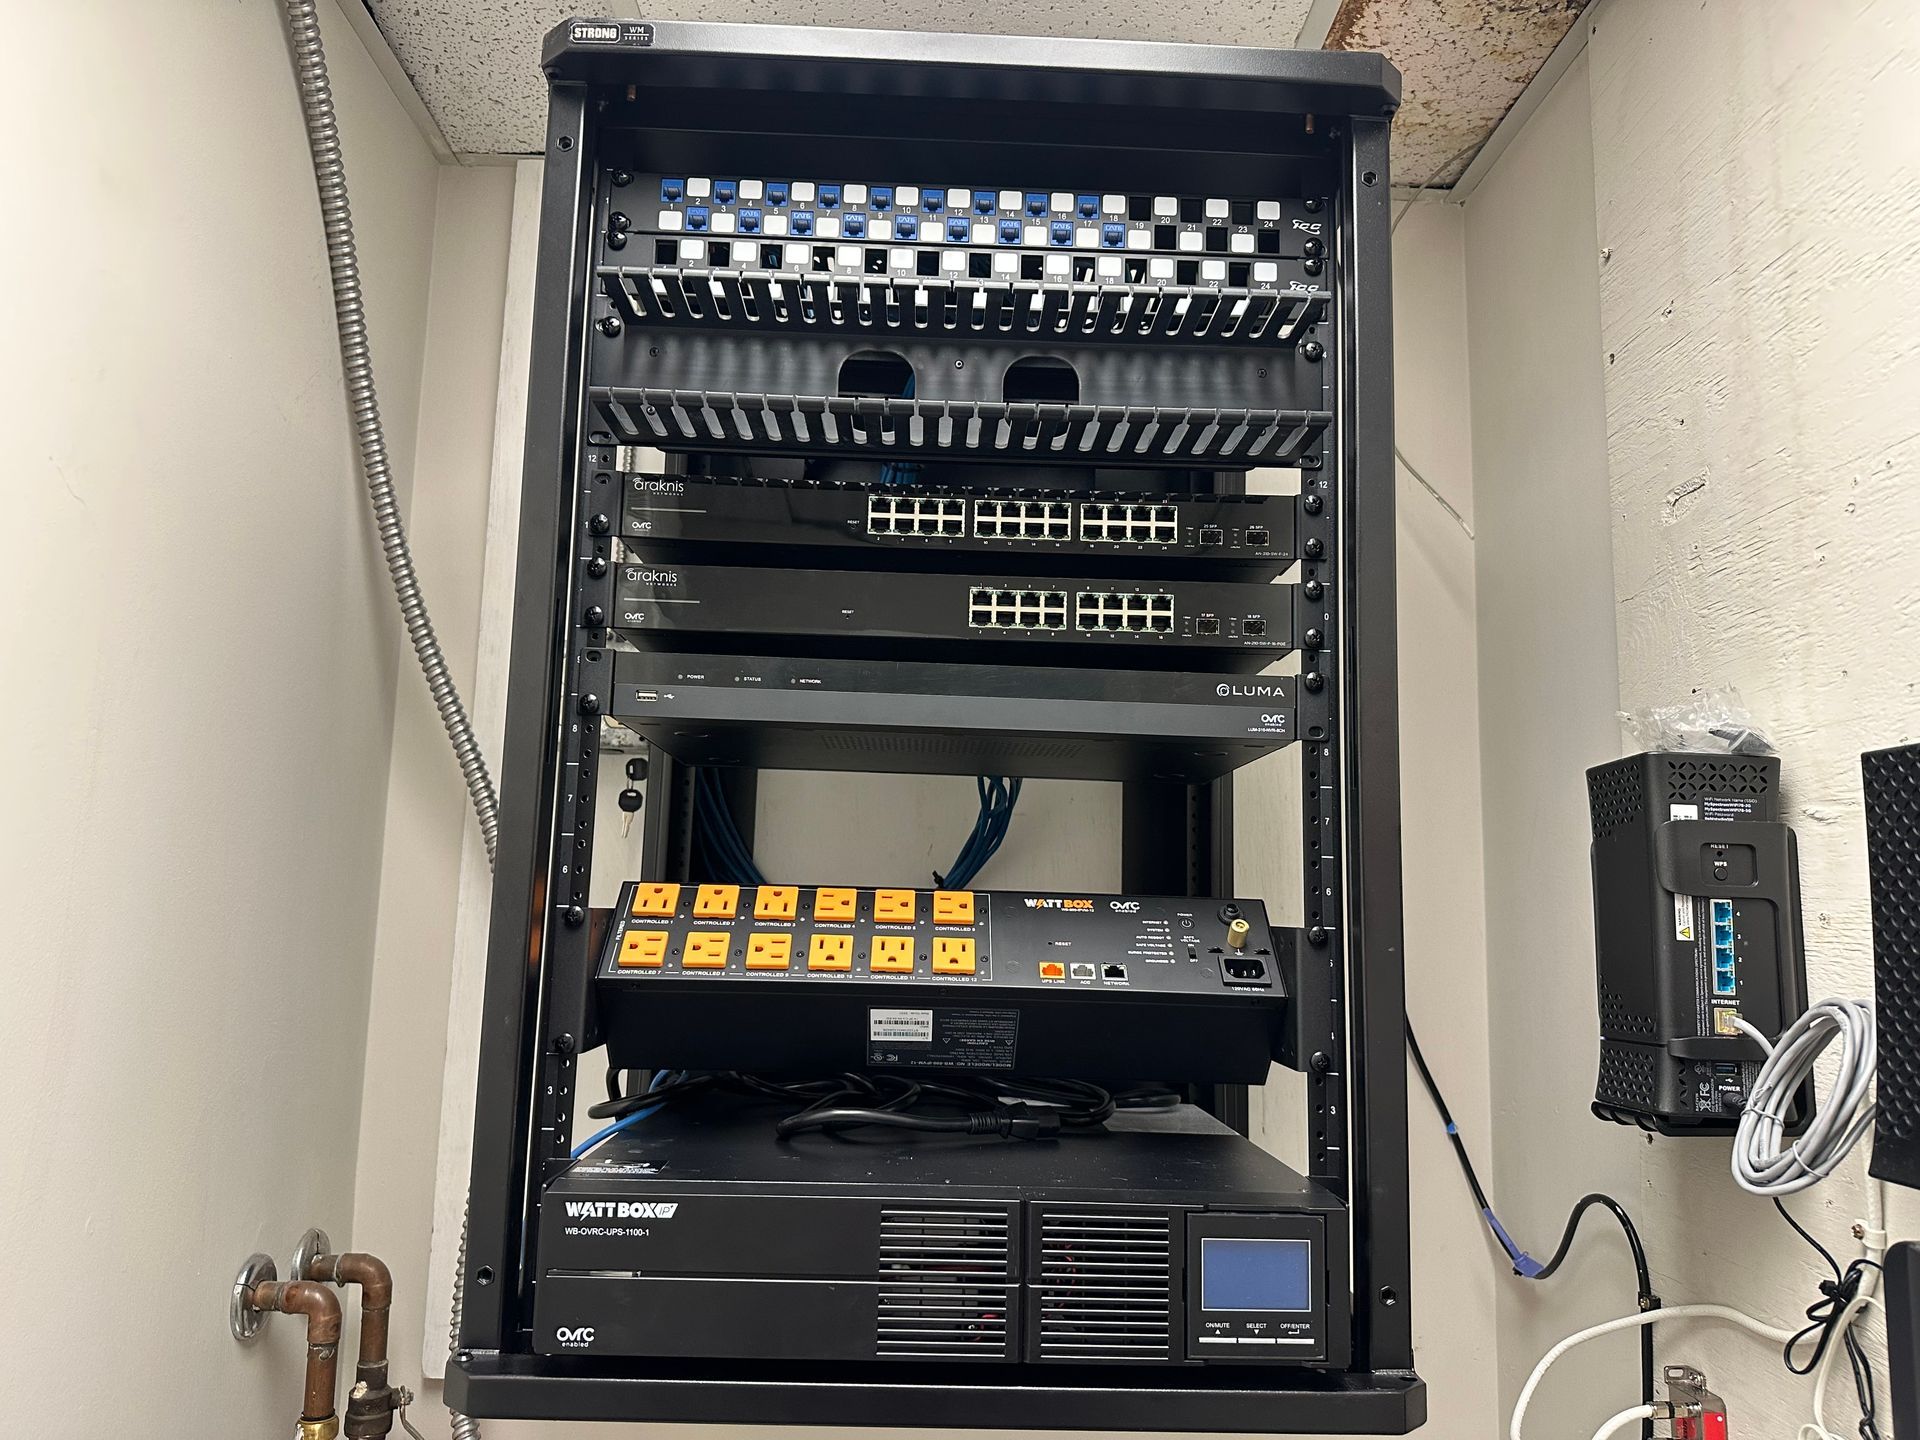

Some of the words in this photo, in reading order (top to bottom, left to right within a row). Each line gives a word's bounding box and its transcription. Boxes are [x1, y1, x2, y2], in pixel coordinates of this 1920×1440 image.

[575, 28, 617, 38] STRONG
[748, 200, 752, 208] 4
[955, 209, 964, 217] 12
[1208, 281, 1218, 289] 22
[1260, 283, 1271, 291] 24
[633, 477, 684, 493] araknis
[626, 568, 677, 582] araknis
[1233, 686, 1284, 696] LUMA
[568, 794, 572, 802] 7
[563, 865, 567, 873] 6
[616, 920, 625, 940] FILTERED
[548, 1086, 552, 1094] 3
[1331, 1106, 1335, 1114] 3
[565, 1227, 649, 1236] WB-OVRC-UPS-1100-1
